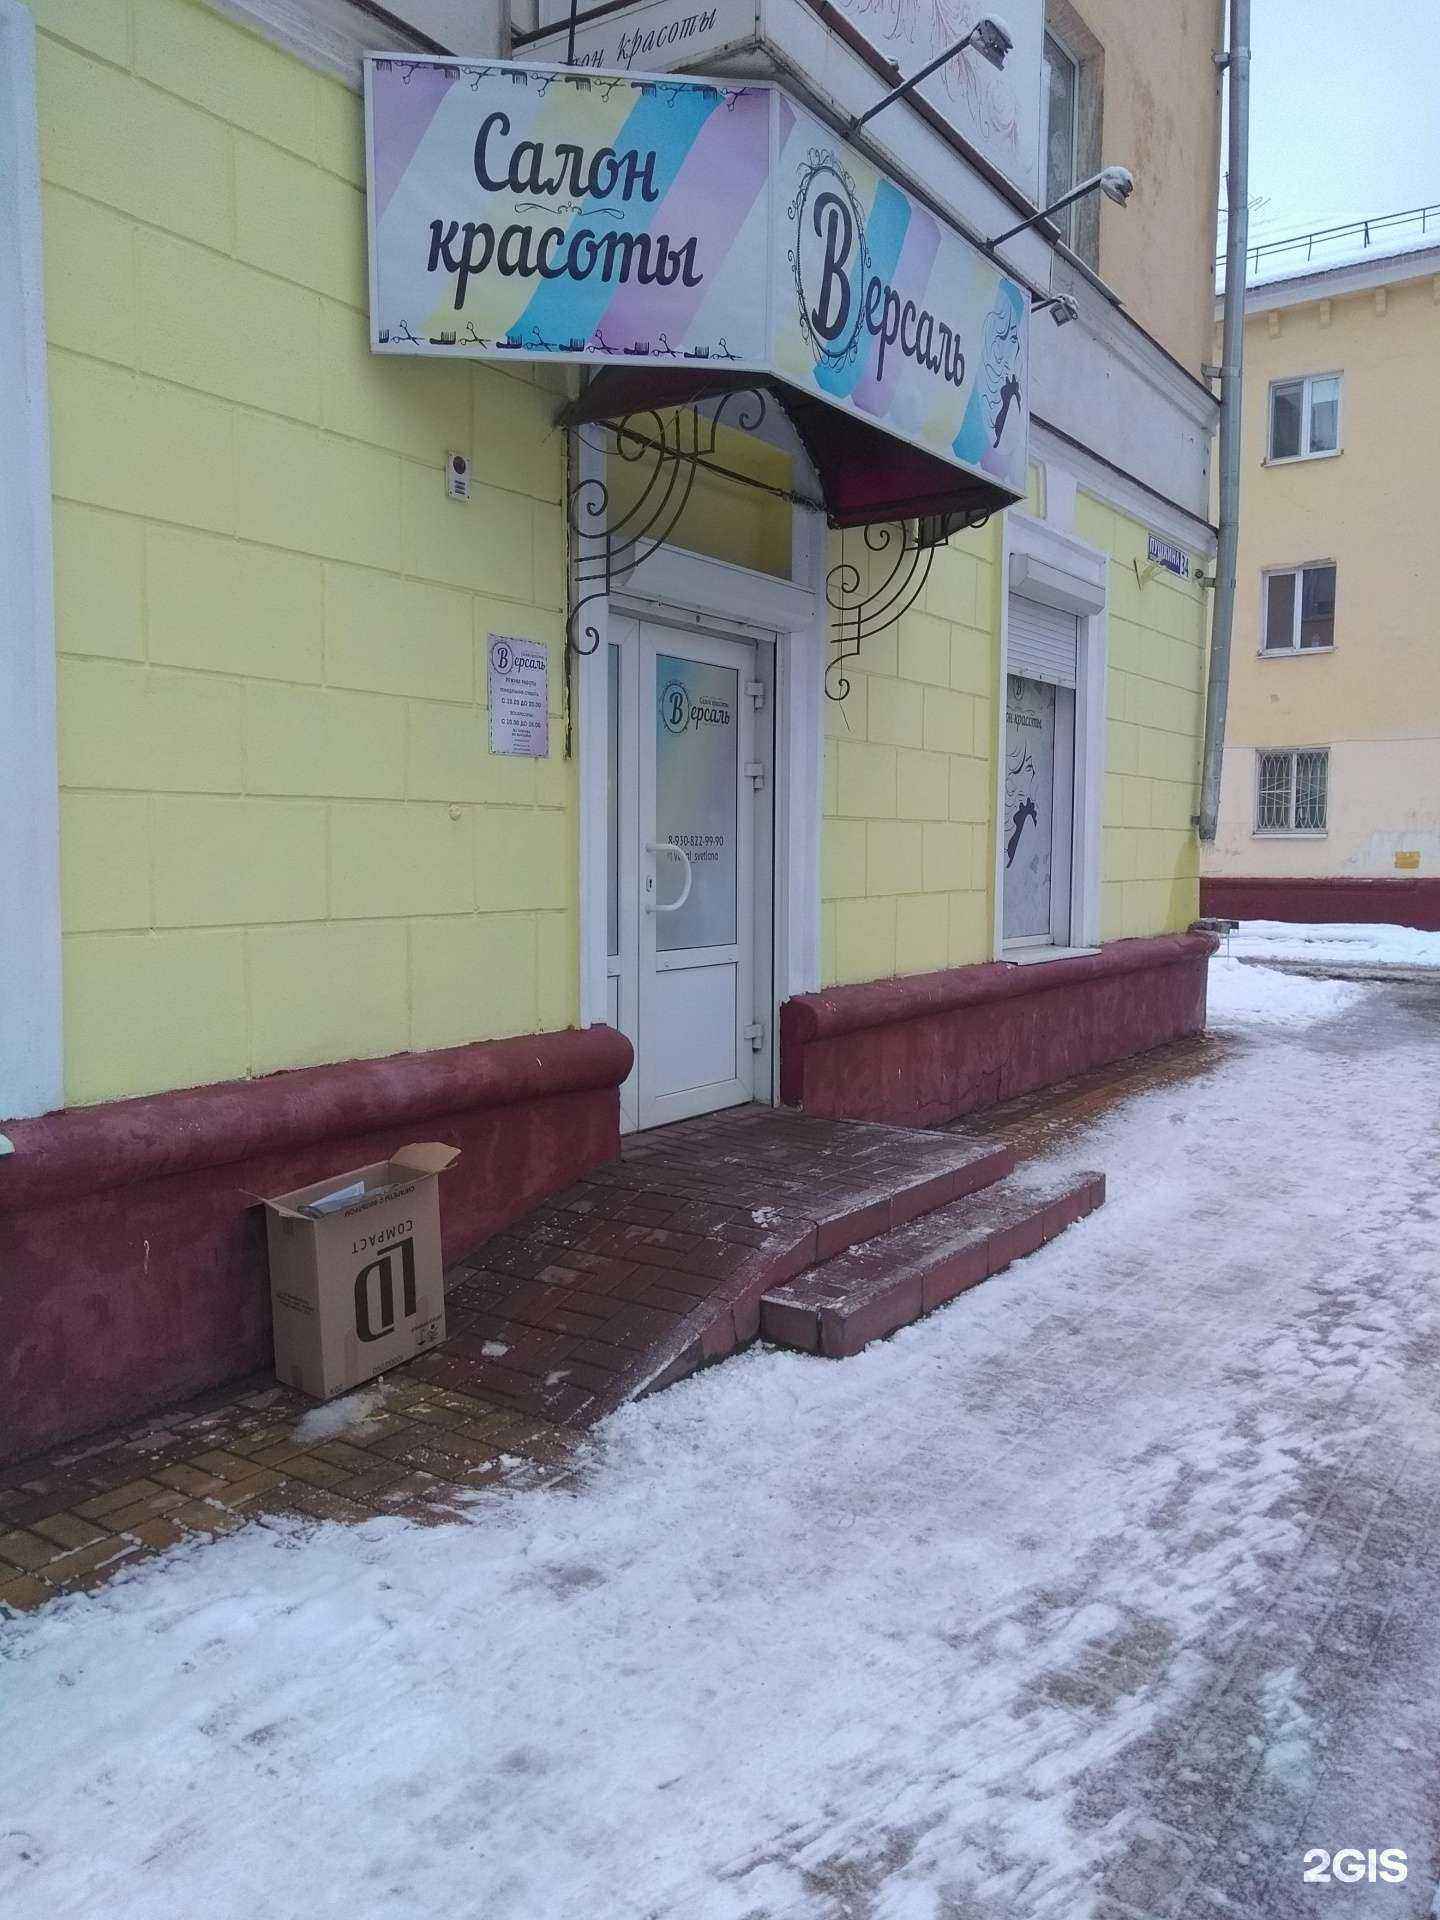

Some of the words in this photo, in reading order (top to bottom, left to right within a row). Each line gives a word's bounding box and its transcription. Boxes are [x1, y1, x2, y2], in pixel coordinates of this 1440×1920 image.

[616, 8, 717, 71] красоты
[473, 111, 660, 202] Салон
[426, 218, 704, 311] красоты
[811, 191, 966, 388] Версаль
[497, 647, 546, 673] Версаль
[669, 691, 730, 731] Версаль
[351, 1219, 413, 1255] COMPACT
[354, 1236, 417, 1343] LD
